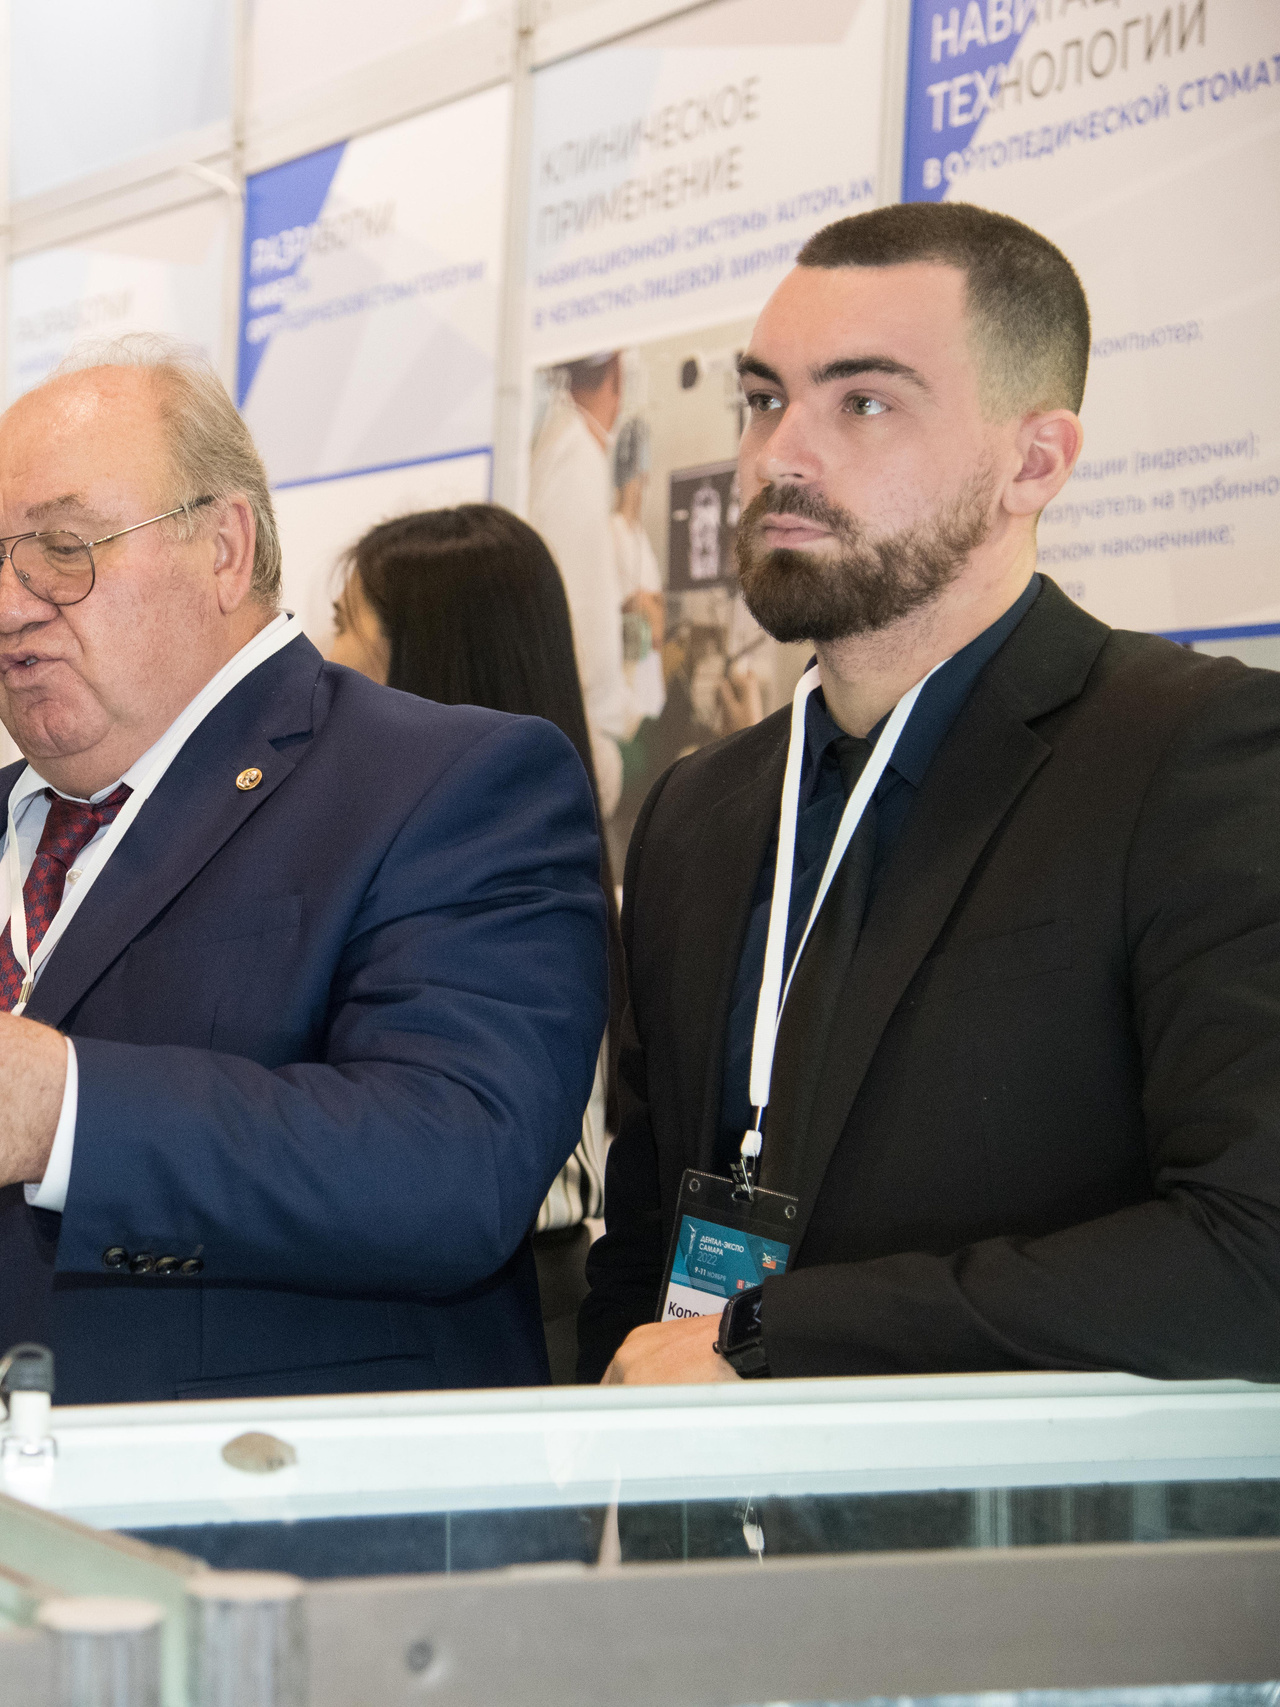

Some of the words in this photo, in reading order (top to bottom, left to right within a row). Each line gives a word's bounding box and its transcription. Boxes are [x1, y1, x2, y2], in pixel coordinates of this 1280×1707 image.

[926, 0, 1207, 133] ТЕХНОЛОГИИ
[542, 75, 761, 188] КЛИНИЧЕСКОЕ
[923, 157, 942, 189] В
[942, 84, 1170, 184] ОРТОПЕДИЧЕСКОЙ
[538, 145, 743, 247] ПРИМЕНЕНИЕ
[698, 1243, 724, 1256] САМАРА
[700, 1235, 745, 1253] ДЕНТАЛ-ЭКСПО
[697, 1251, 718, 1266] 2022
[694, 1266, 707, 1277] 9-11
[668, 1301, 707, 1318] Кор
